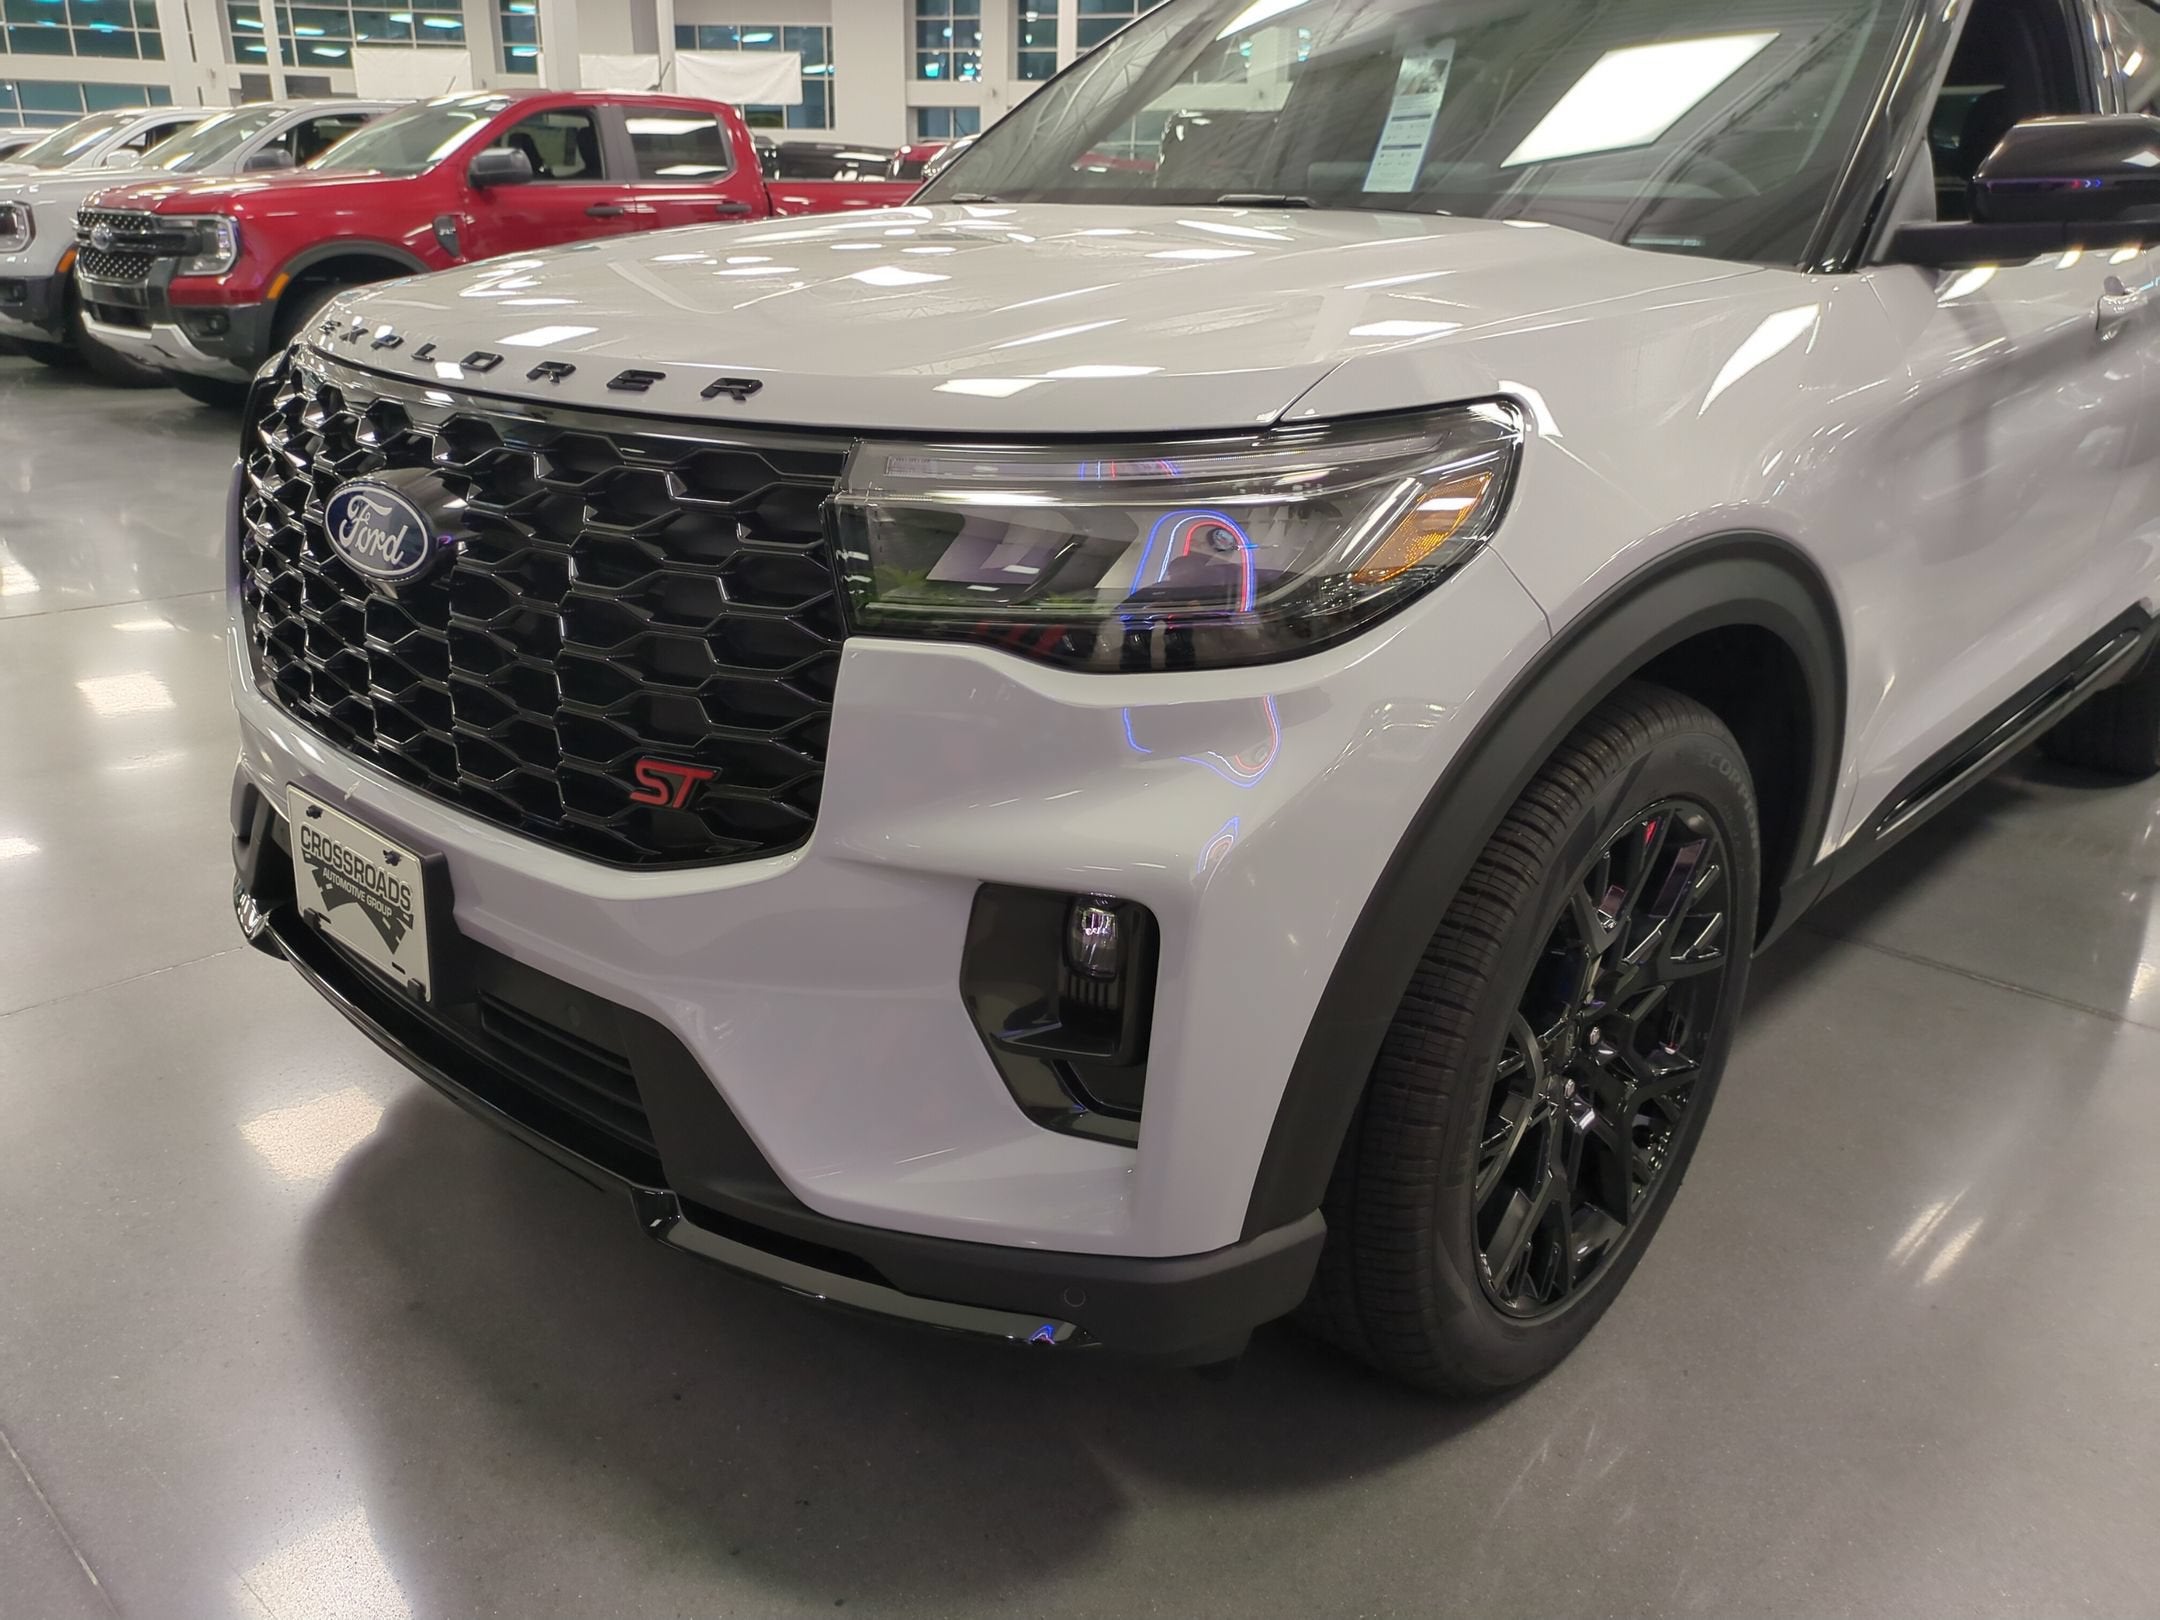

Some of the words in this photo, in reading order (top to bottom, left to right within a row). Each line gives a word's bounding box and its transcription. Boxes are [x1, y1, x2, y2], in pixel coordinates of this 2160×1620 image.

[319, 320, 763, 401] EXPLORER
[338, 494, 407, 565] Ford
[629, 759, 715, 808] ST
[300, 825, 412, 912] CROSSROADS
[323, 867, 366, 902] AUTOMOTIVE
[366, 894, 392, 917] GROUP
